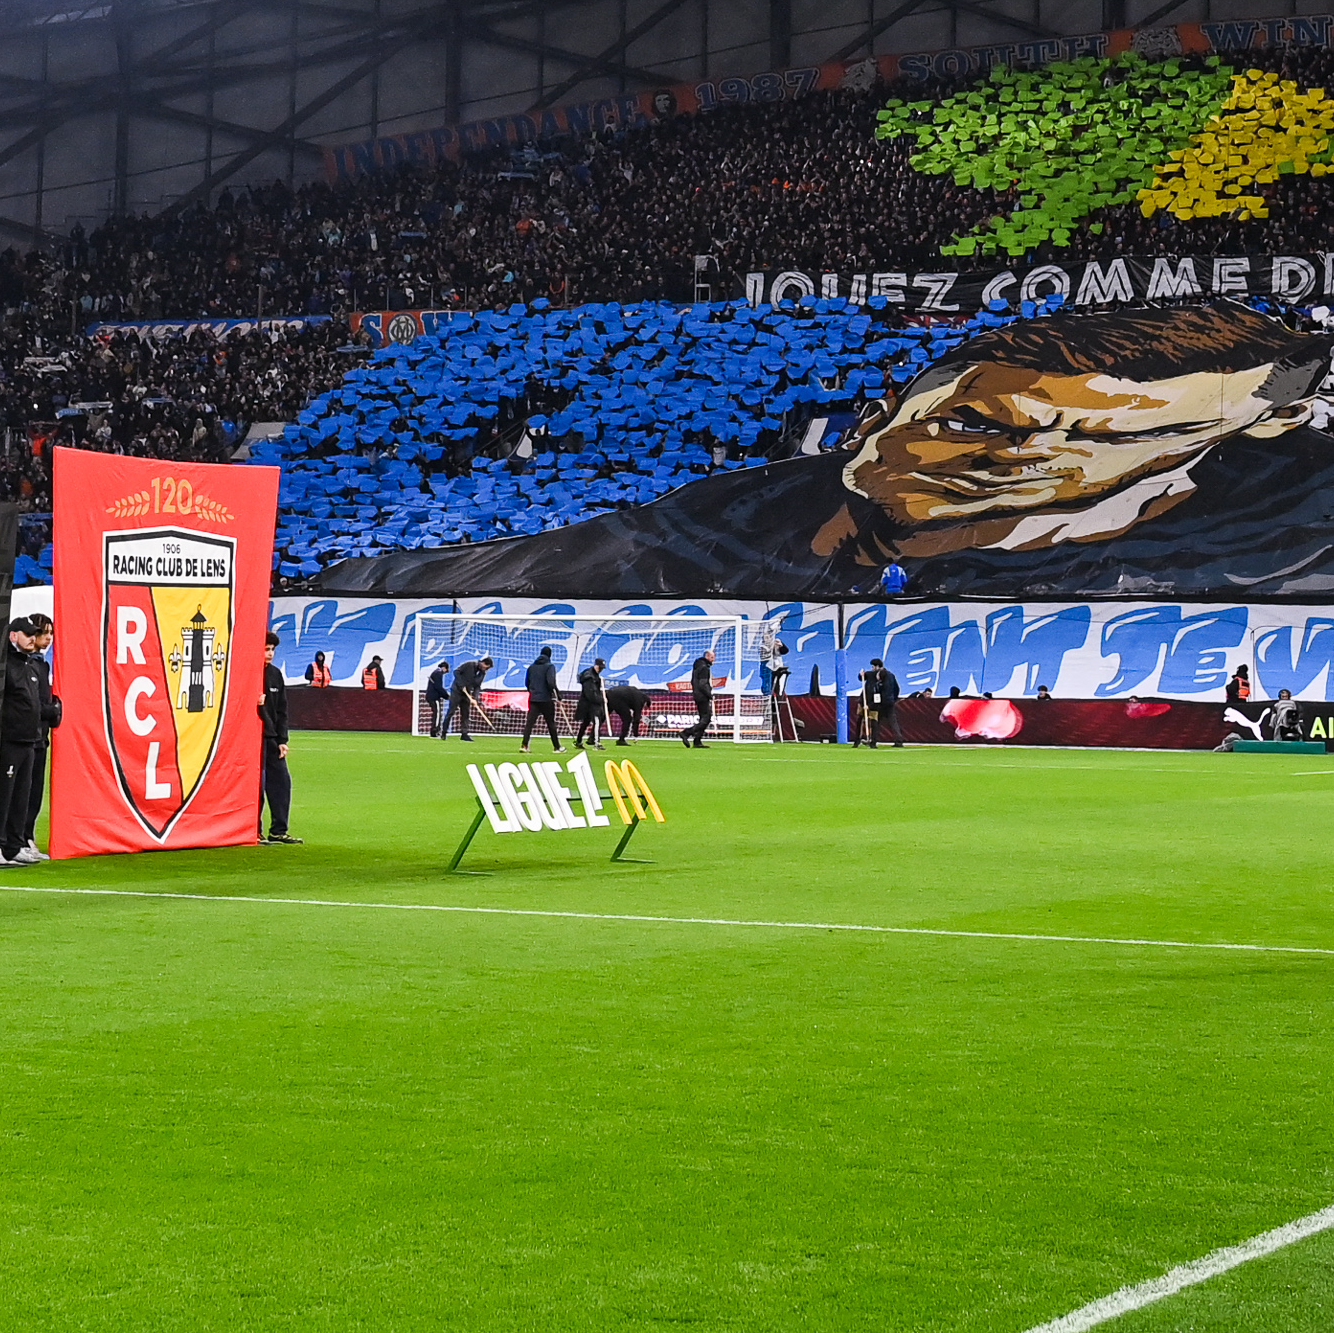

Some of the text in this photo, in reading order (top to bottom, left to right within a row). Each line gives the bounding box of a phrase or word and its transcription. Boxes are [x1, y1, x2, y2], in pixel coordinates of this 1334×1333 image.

[695, 67, 821, 112] 1987
[897, 34, 1111, 83] SOUTH
[982, 256, 1250, 308] COMME
[151, 477, 193, 516] 120
[112, 554, 226, 579] RACING CLUB DE LENS
[162, 542, 181, 555] 1906
[1094, 604, 1248, 698] JE
[675, 682, 693, 691] KAOTI
